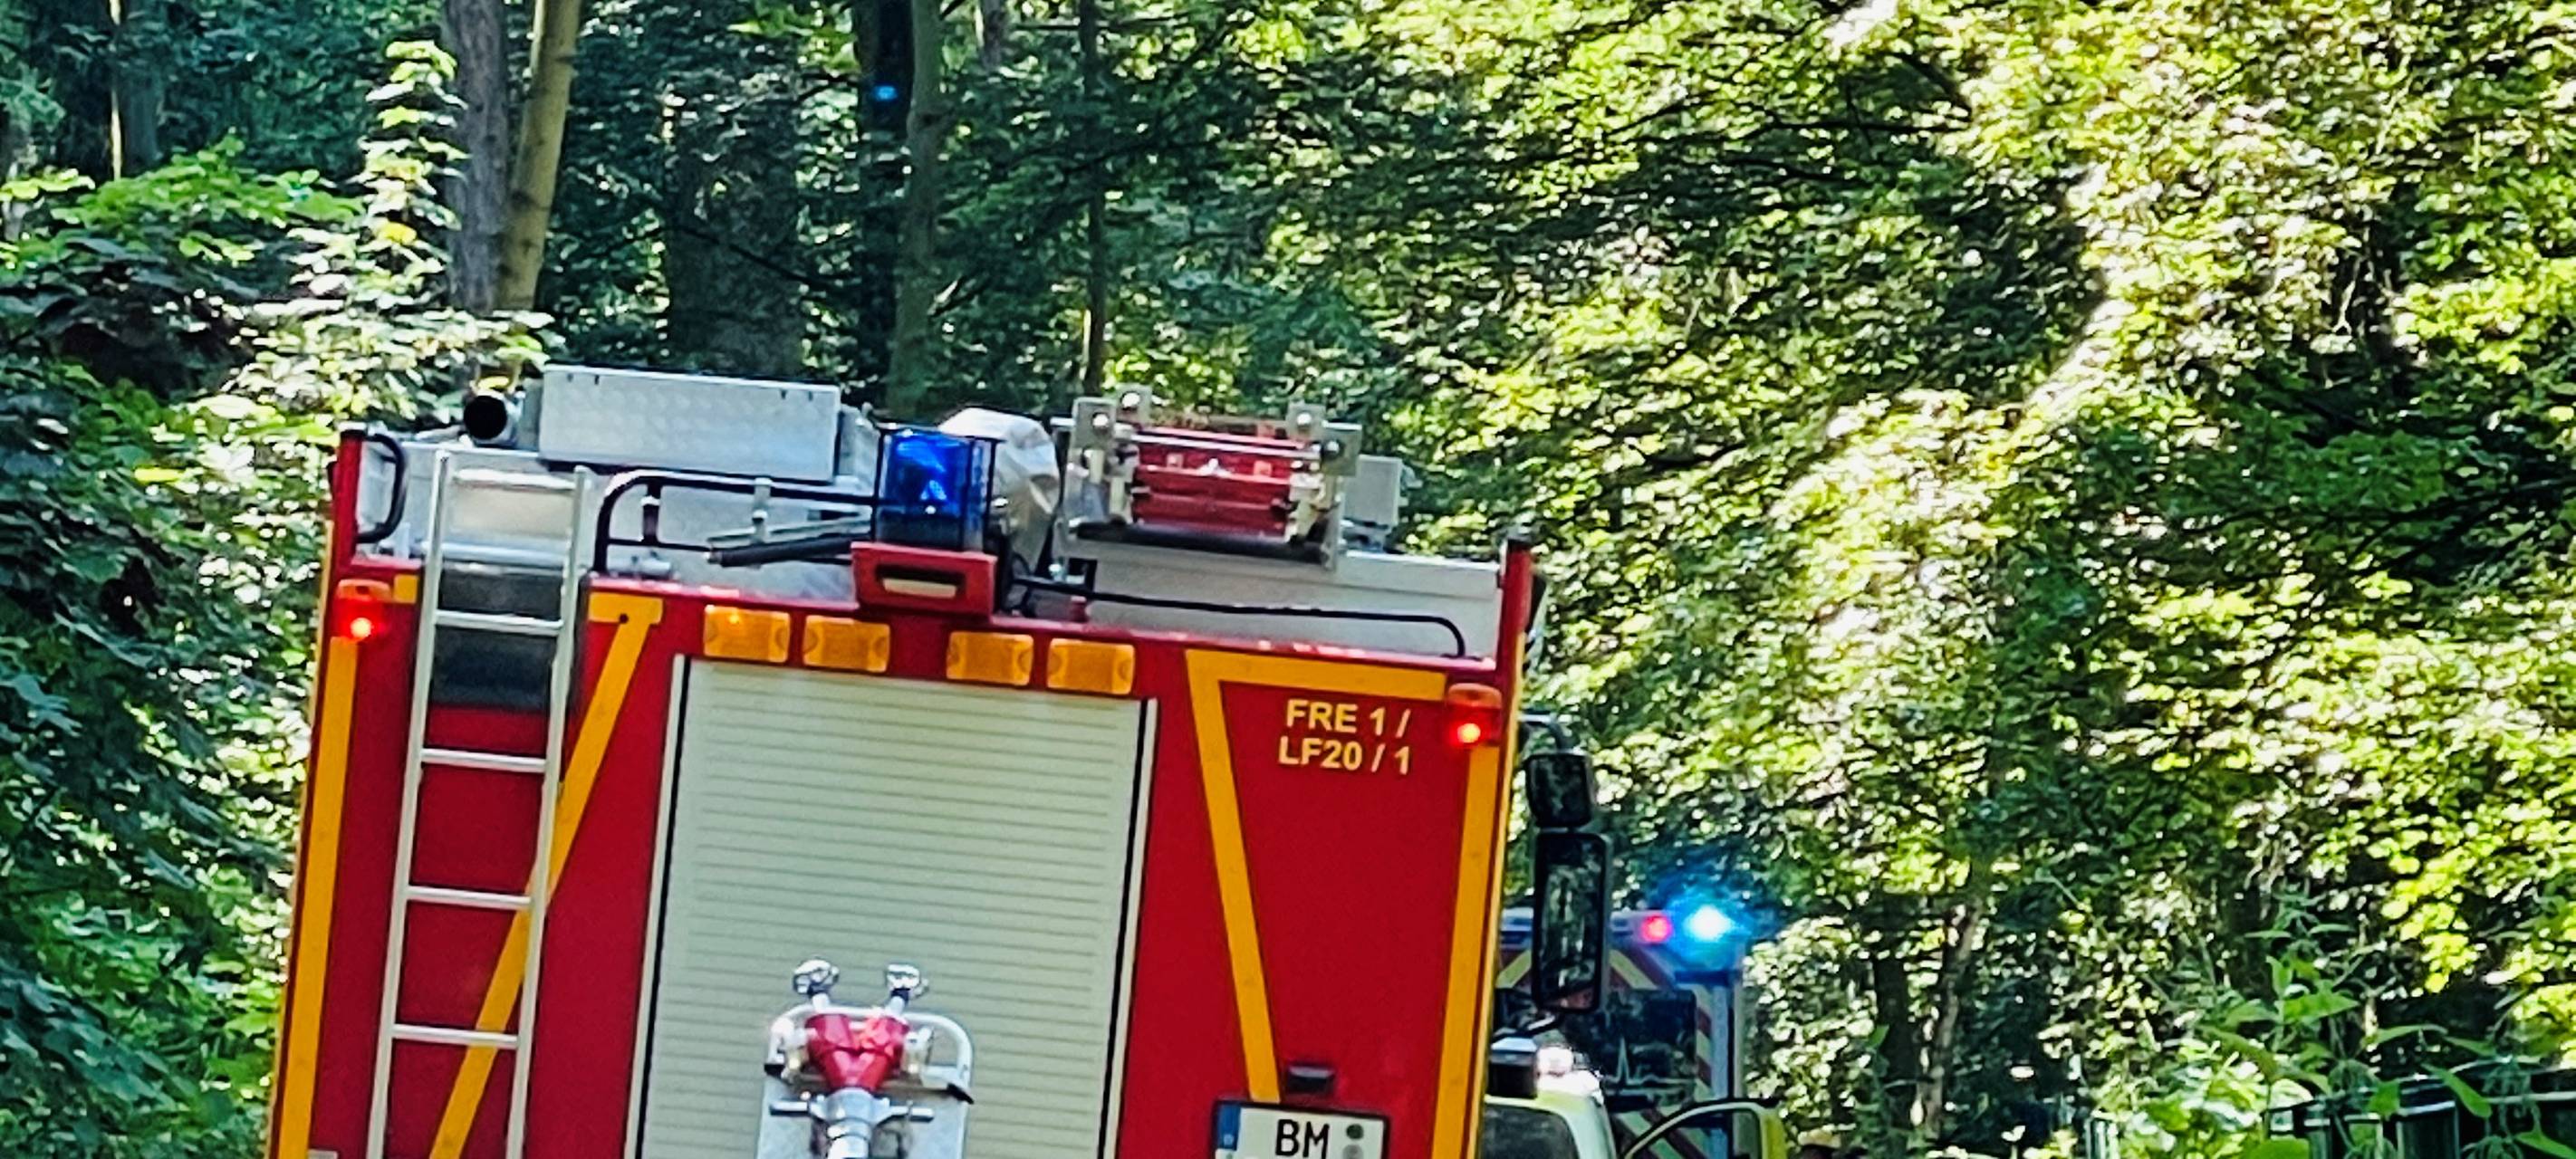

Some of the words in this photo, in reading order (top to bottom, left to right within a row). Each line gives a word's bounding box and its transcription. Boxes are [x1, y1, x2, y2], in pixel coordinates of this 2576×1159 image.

[1286, 699, 1358, 733] FRE
[1370, 707, 1386, 736] 1
[1396, 708, 1411, 738] /
[1278, 735, 1362, 771] LF20
[1394, 745, 1410, 775] 1
[1274, 1118, 1330, 1159] BM
